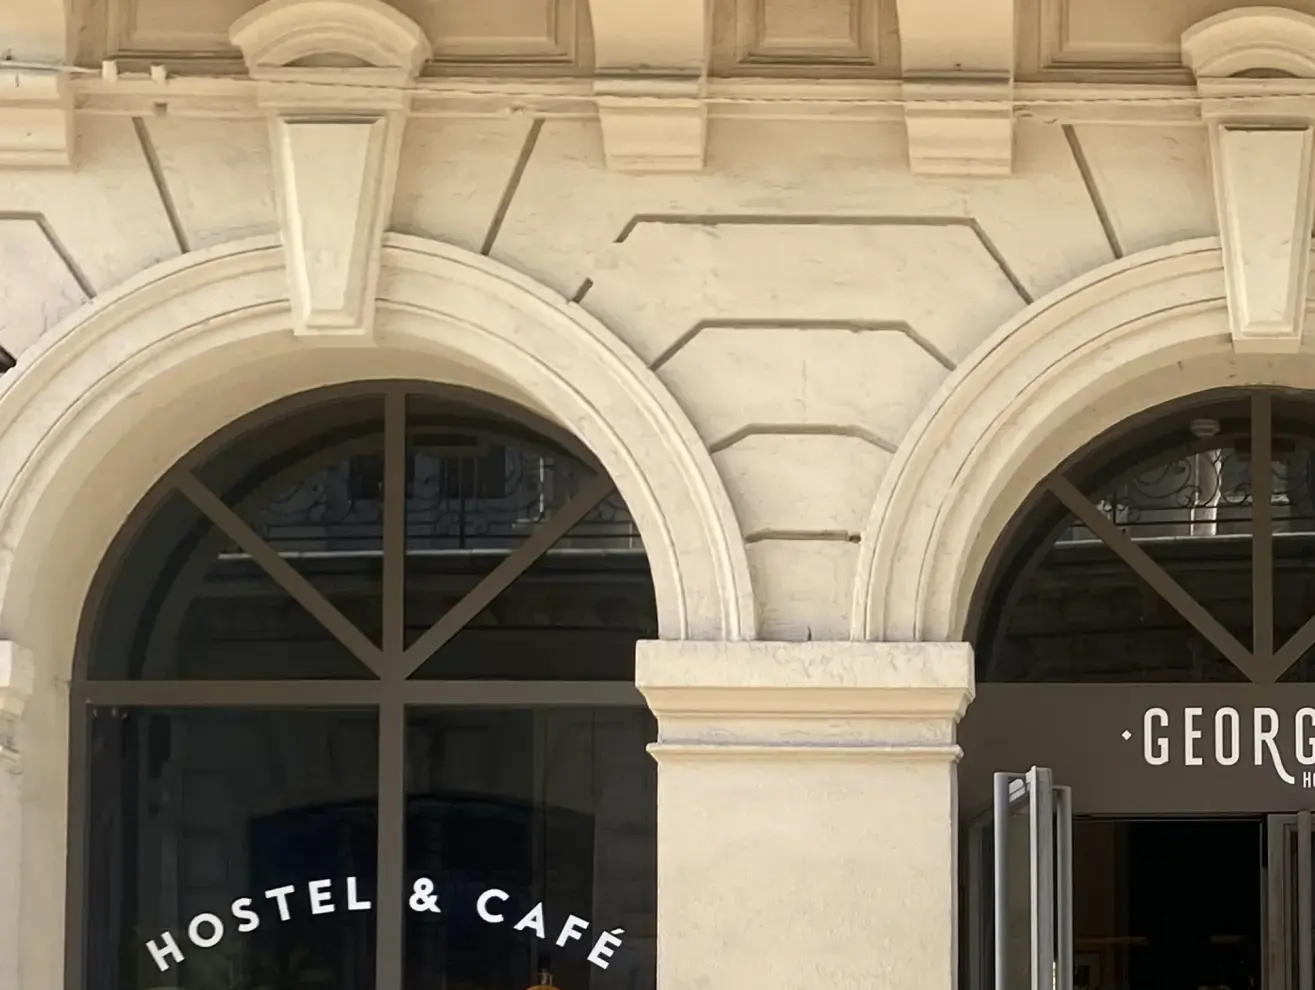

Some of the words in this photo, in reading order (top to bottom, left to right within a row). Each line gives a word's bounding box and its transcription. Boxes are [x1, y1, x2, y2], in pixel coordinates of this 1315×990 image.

[146, 876, 371, 971] HOSTEL
[409, 877, 440, 912] &
[476, 889, 625, 969] CAFÉ
